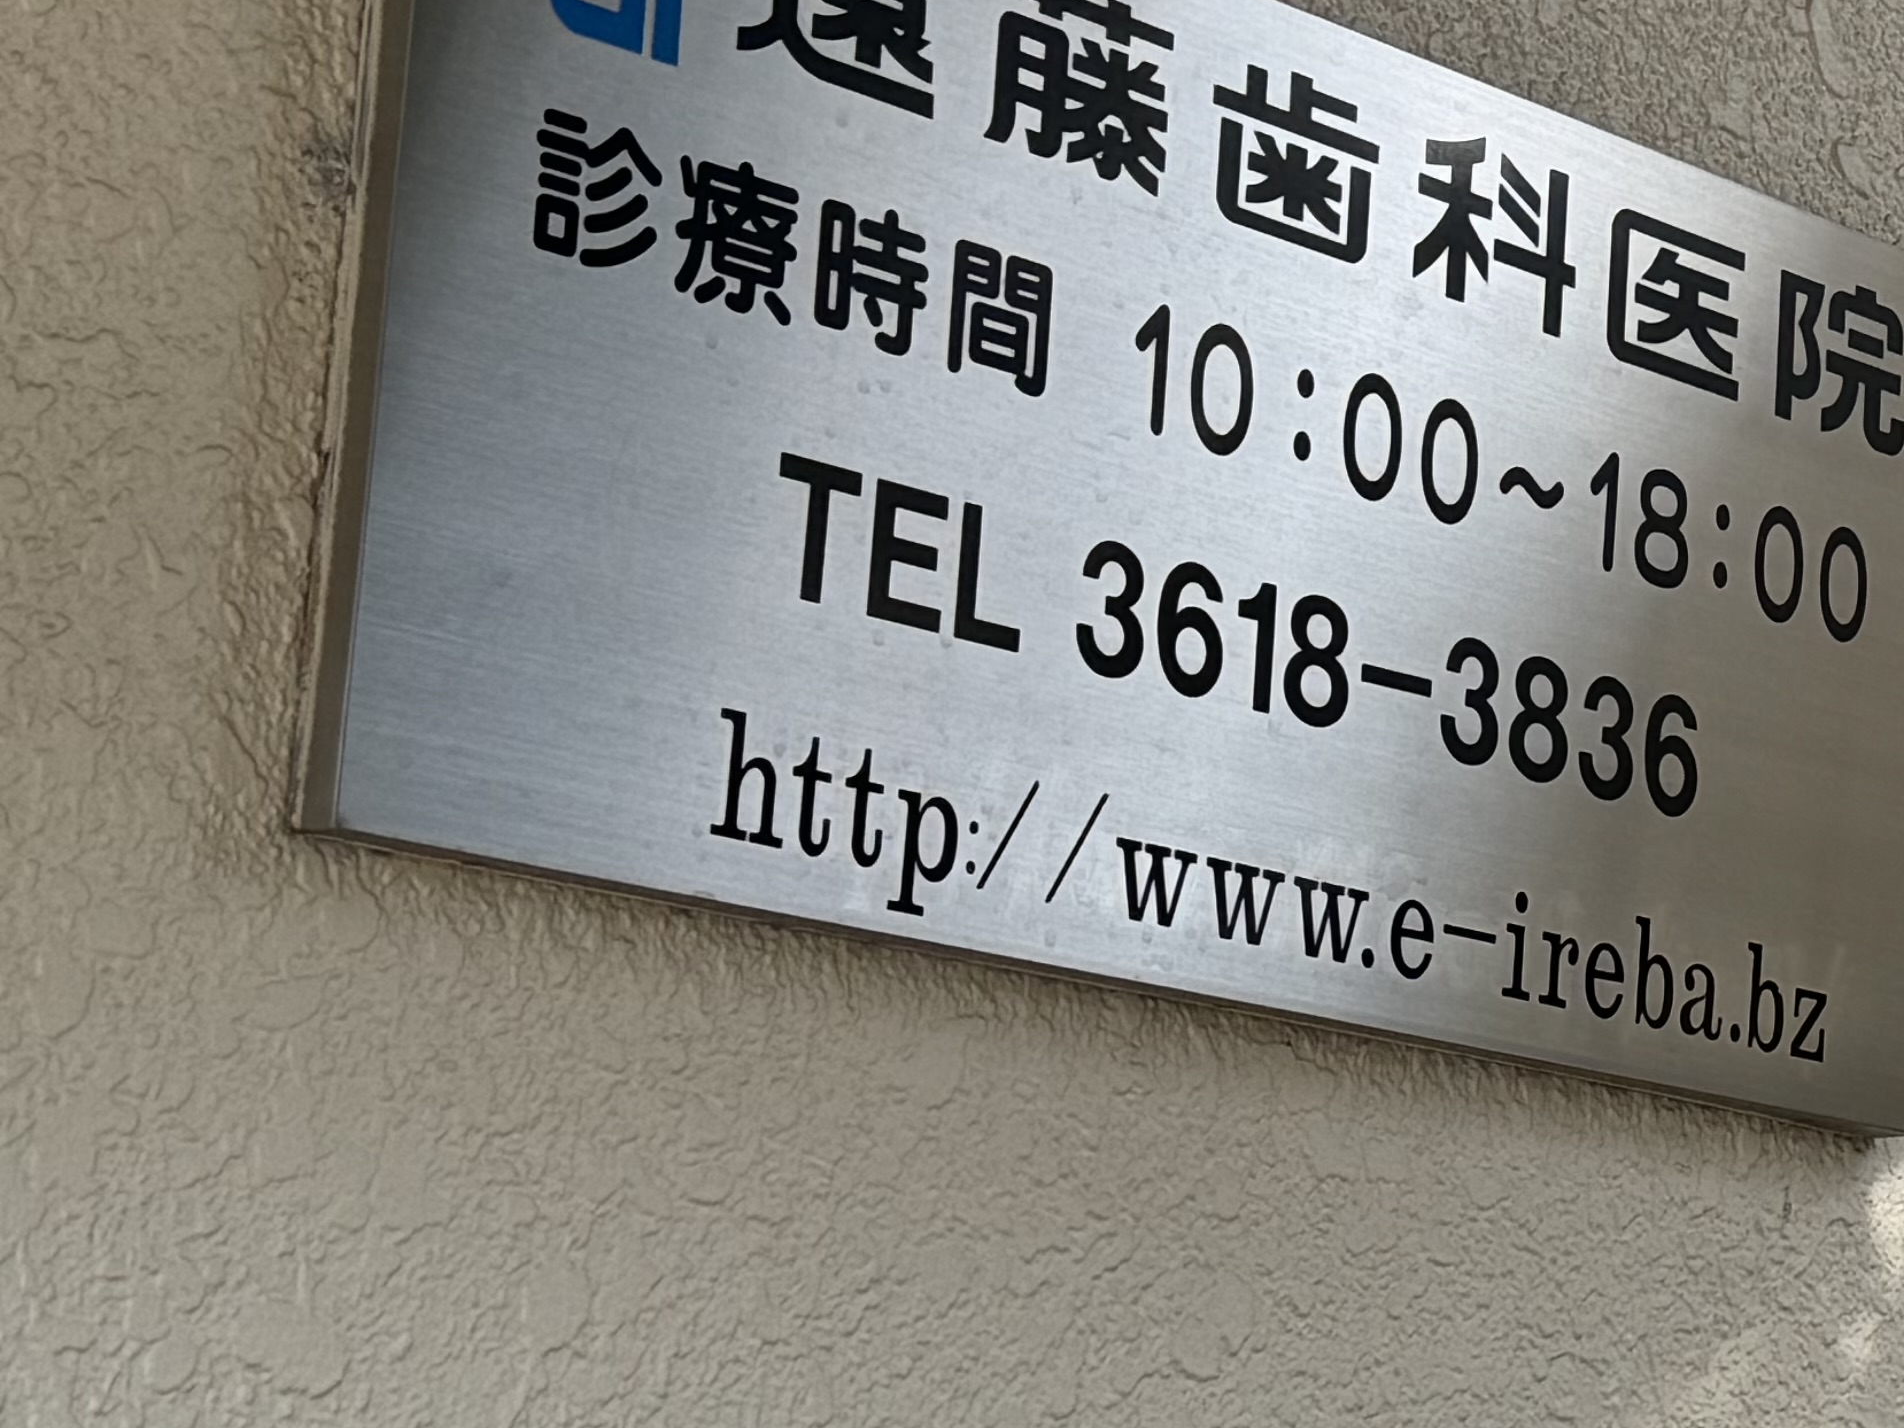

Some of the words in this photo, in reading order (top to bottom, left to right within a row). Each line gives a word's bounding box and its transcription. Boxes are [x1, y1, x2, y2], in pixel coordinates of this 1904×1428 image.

[531, 107, 1054, 398] 診療時間
[778, 452, 1022, 654] TEL
[1075, 539, 1699, 819] 3618-3836
[708, 706, 1829, 1065] http://www.e-ireba.bz
